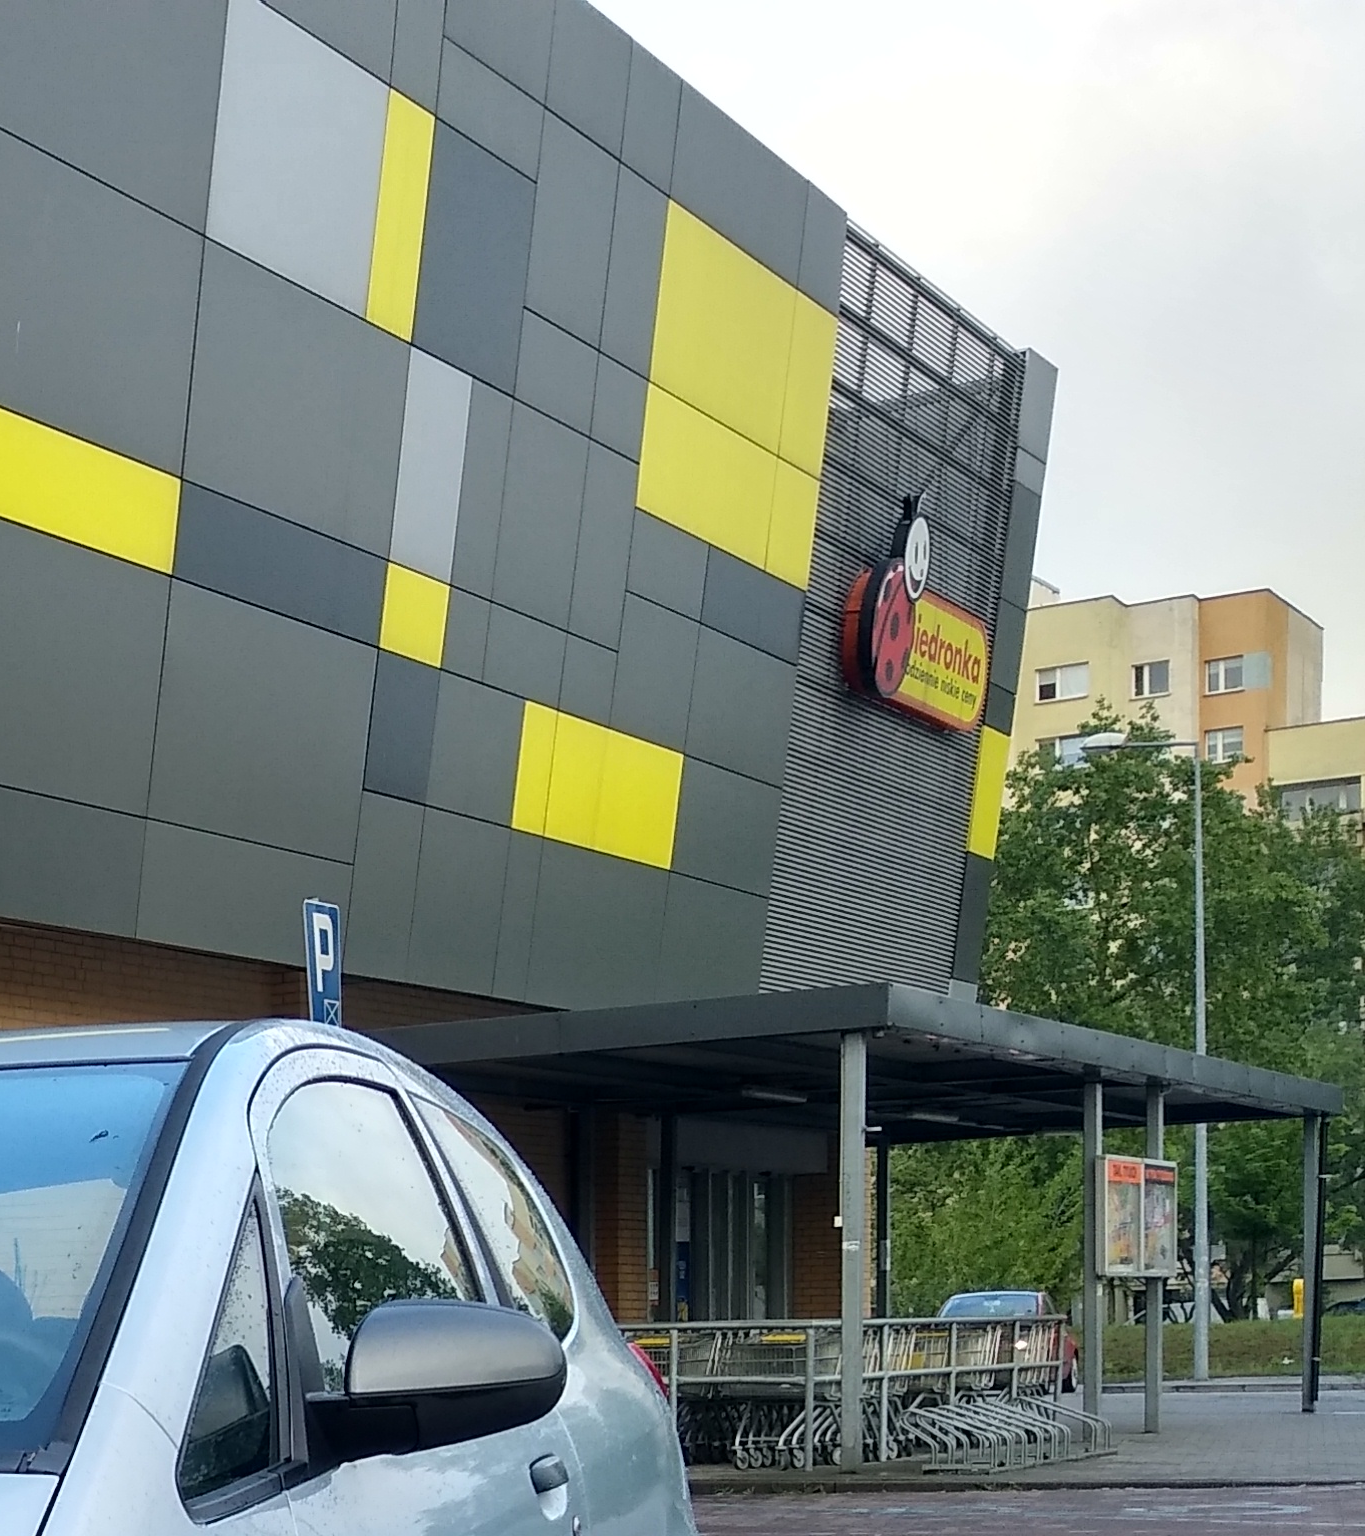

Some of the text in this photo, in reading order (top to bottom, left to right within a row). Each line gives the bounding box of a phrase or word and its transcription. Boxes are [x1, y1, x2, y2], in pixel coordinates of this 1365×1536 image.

[914, 613, 982, 684] iedronka
[961, 690, 977, 710] ceny
[312, 912, 334, 992] P
